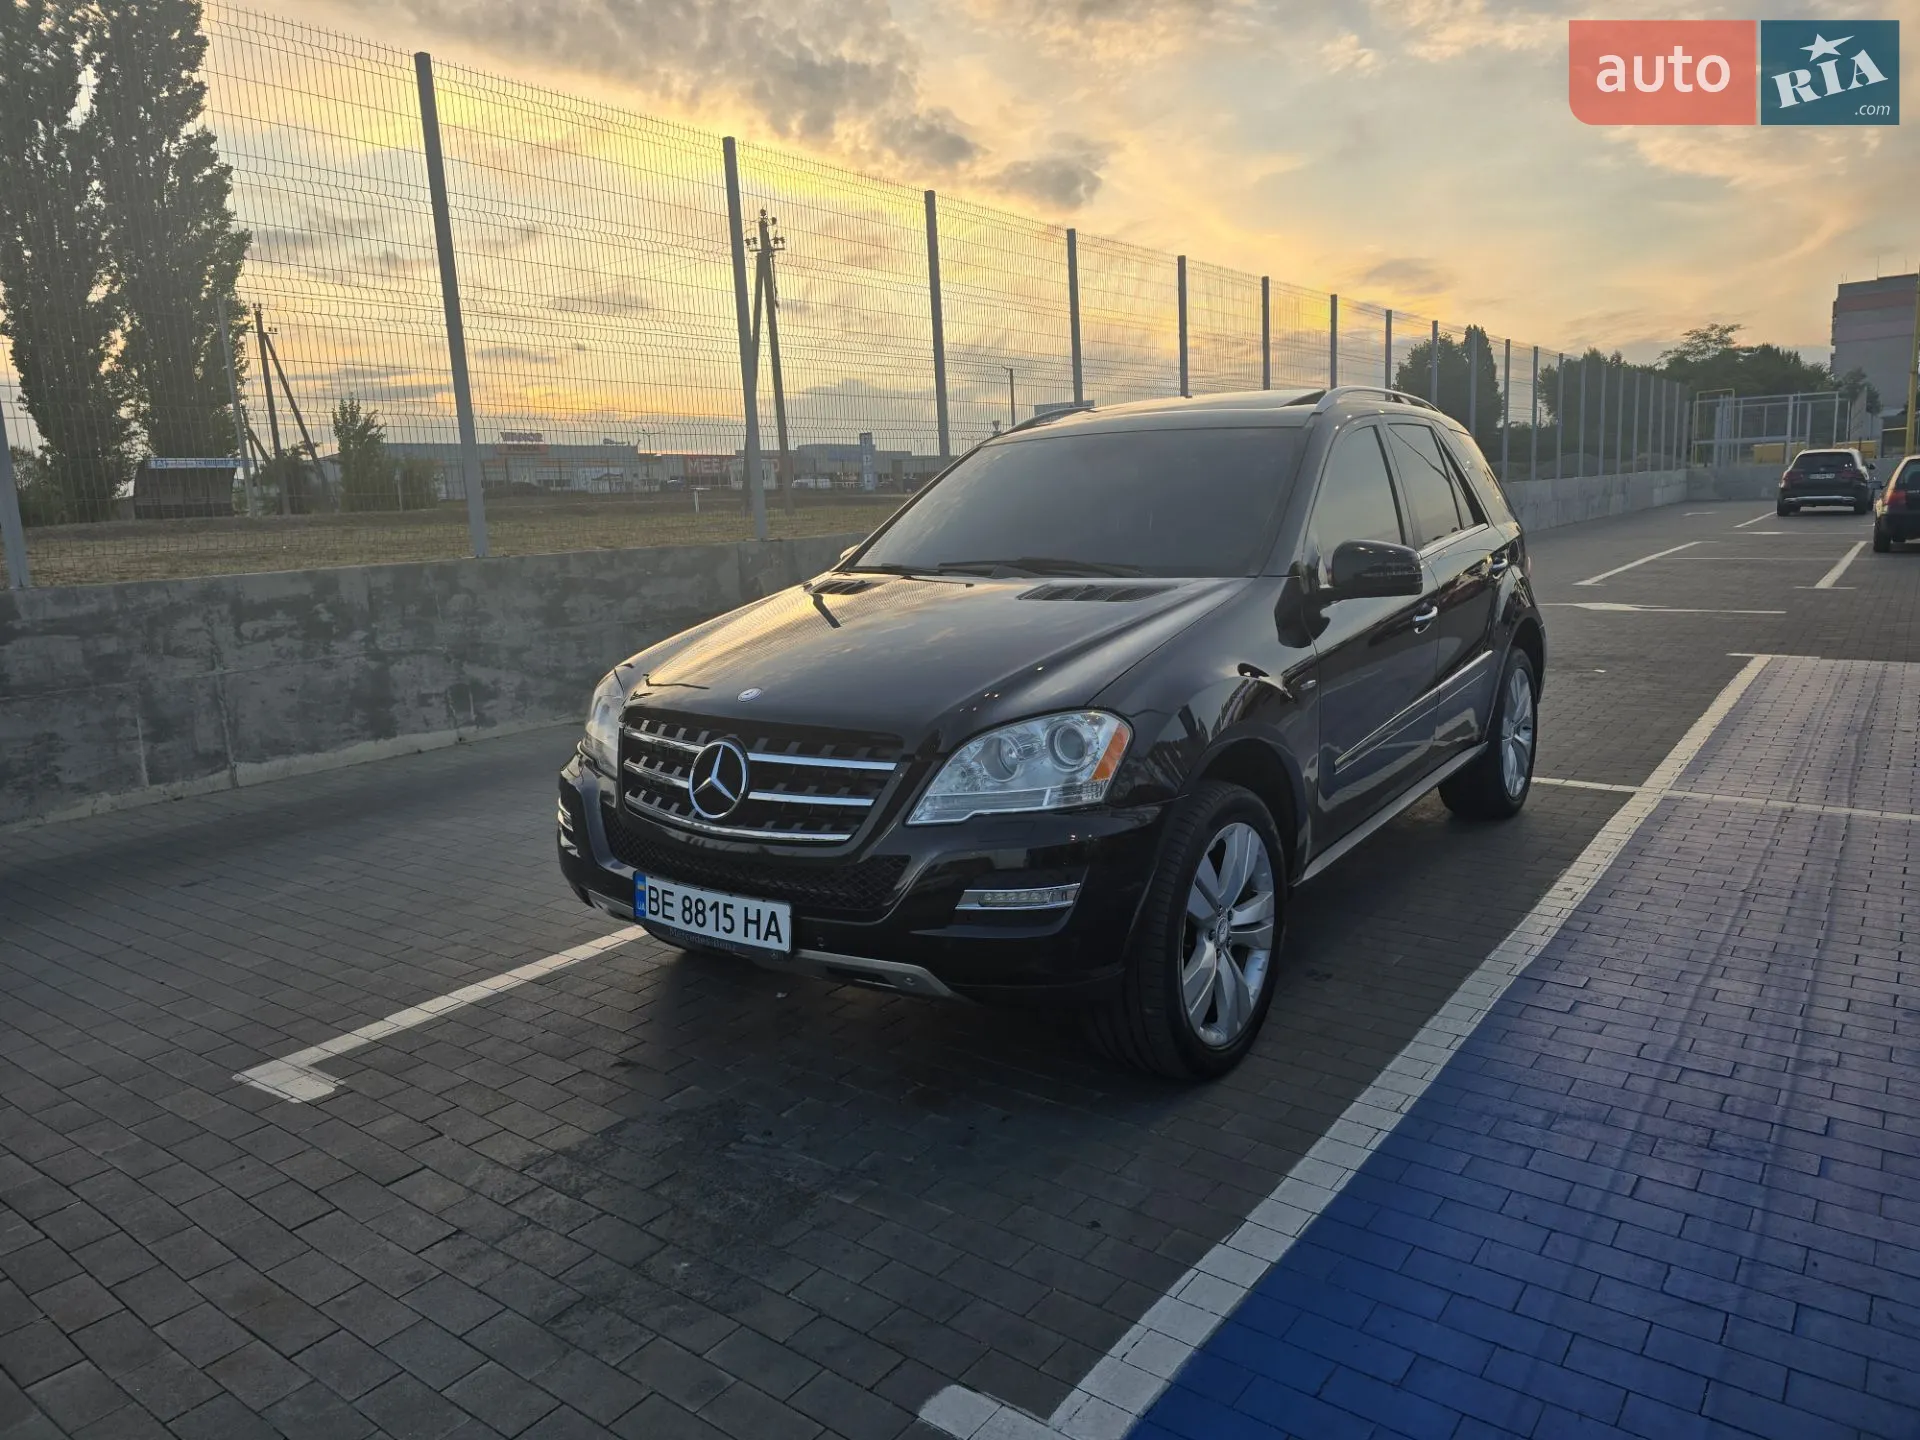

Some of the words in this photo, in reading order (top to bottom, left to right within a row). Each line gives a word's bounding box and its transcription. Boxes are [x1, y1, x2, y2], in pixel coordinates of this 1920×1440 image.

[648, 885, 676, 922] BE
[681, 895, 736, 934] 8815
[743, 907, 783, 944] HA
